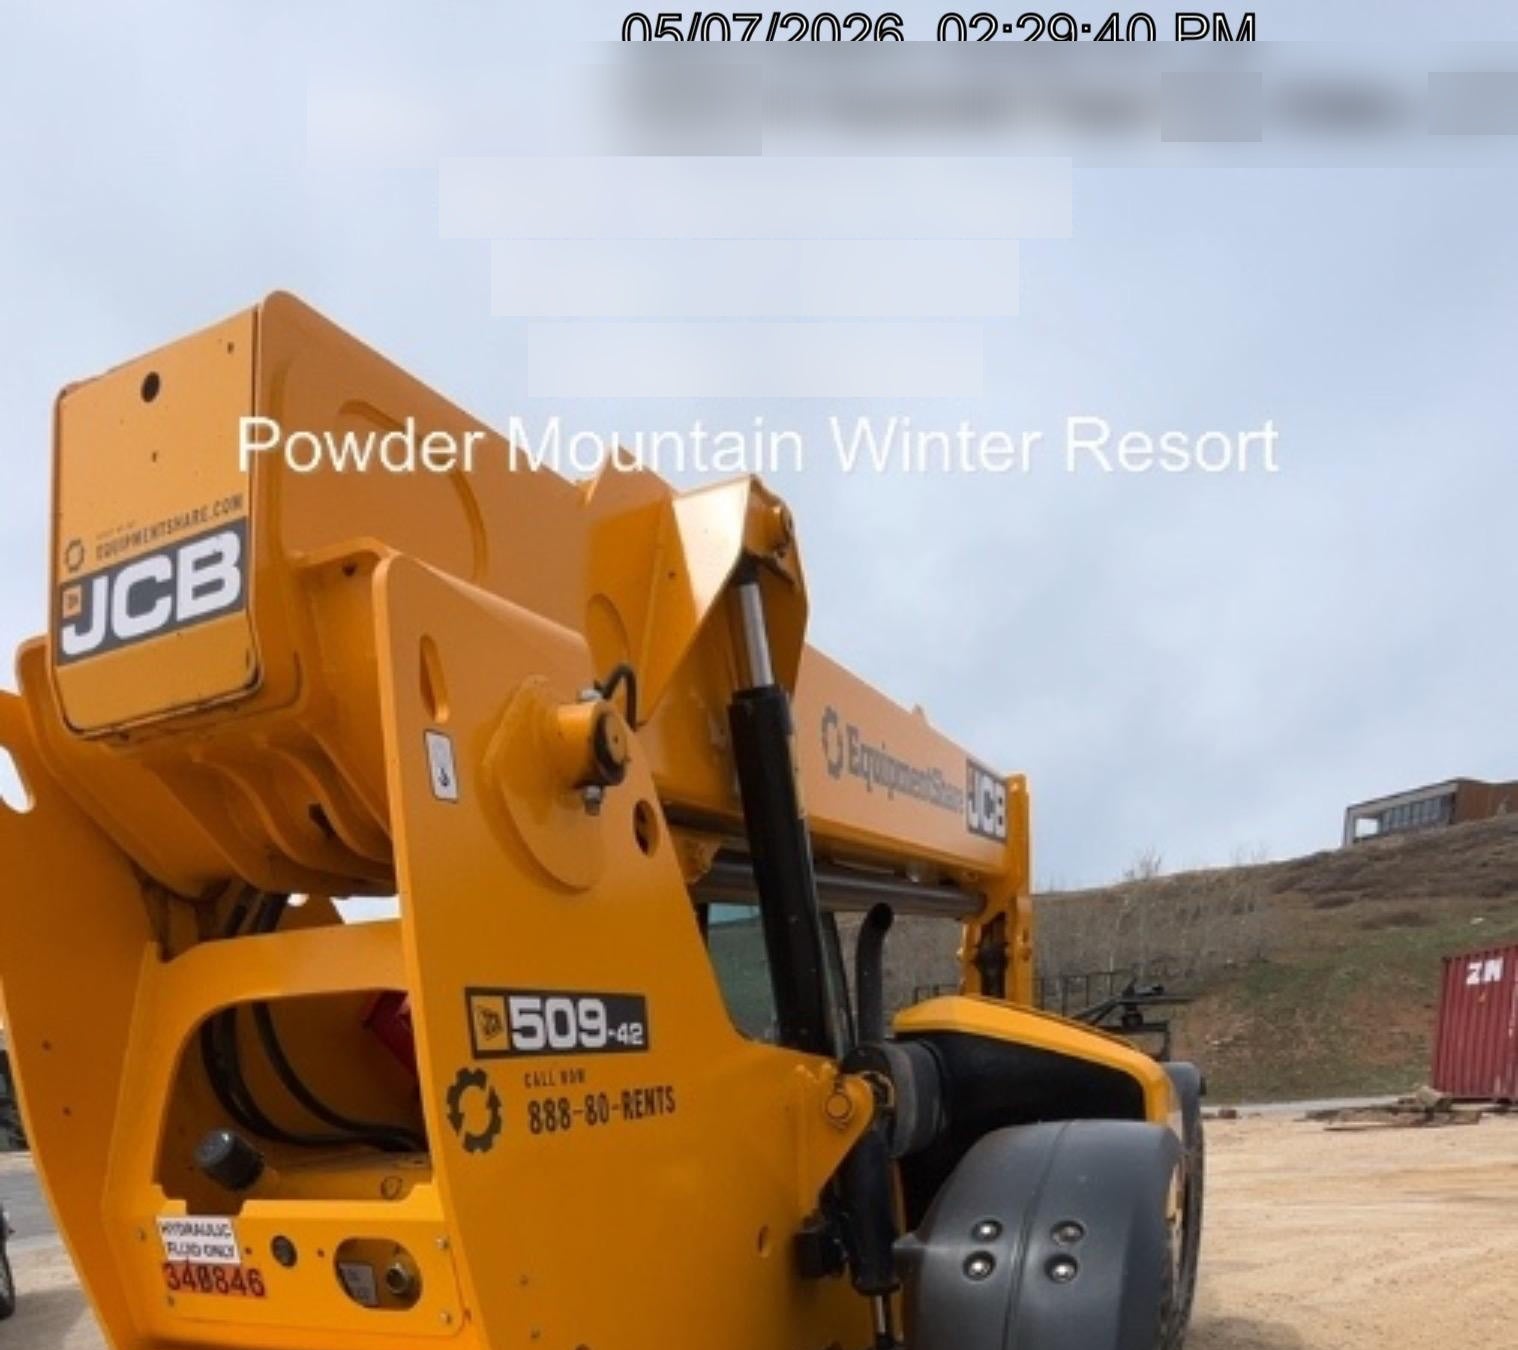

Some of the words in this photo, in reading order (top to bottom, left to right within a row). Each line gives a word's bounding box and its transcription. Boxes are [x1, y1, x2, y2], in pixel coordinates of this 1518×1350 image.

[95, 494, 243, 561] EQUIPMENTSHARE.COM
[61, 529, 242, 657] JCB
[508, 996, 644, 1050] 509-42
[524, 1072, 554, 1089] CALL
[560, 1068, 586, 1085] NOW
[527, 1085, 677, 1135] 888-80-RENTS
[160, 1220, 232, 1238] HYDRAULIC
[166, 1240, 202, 1257] FLUID
[203, 1244, 235, 1258] ONLY
